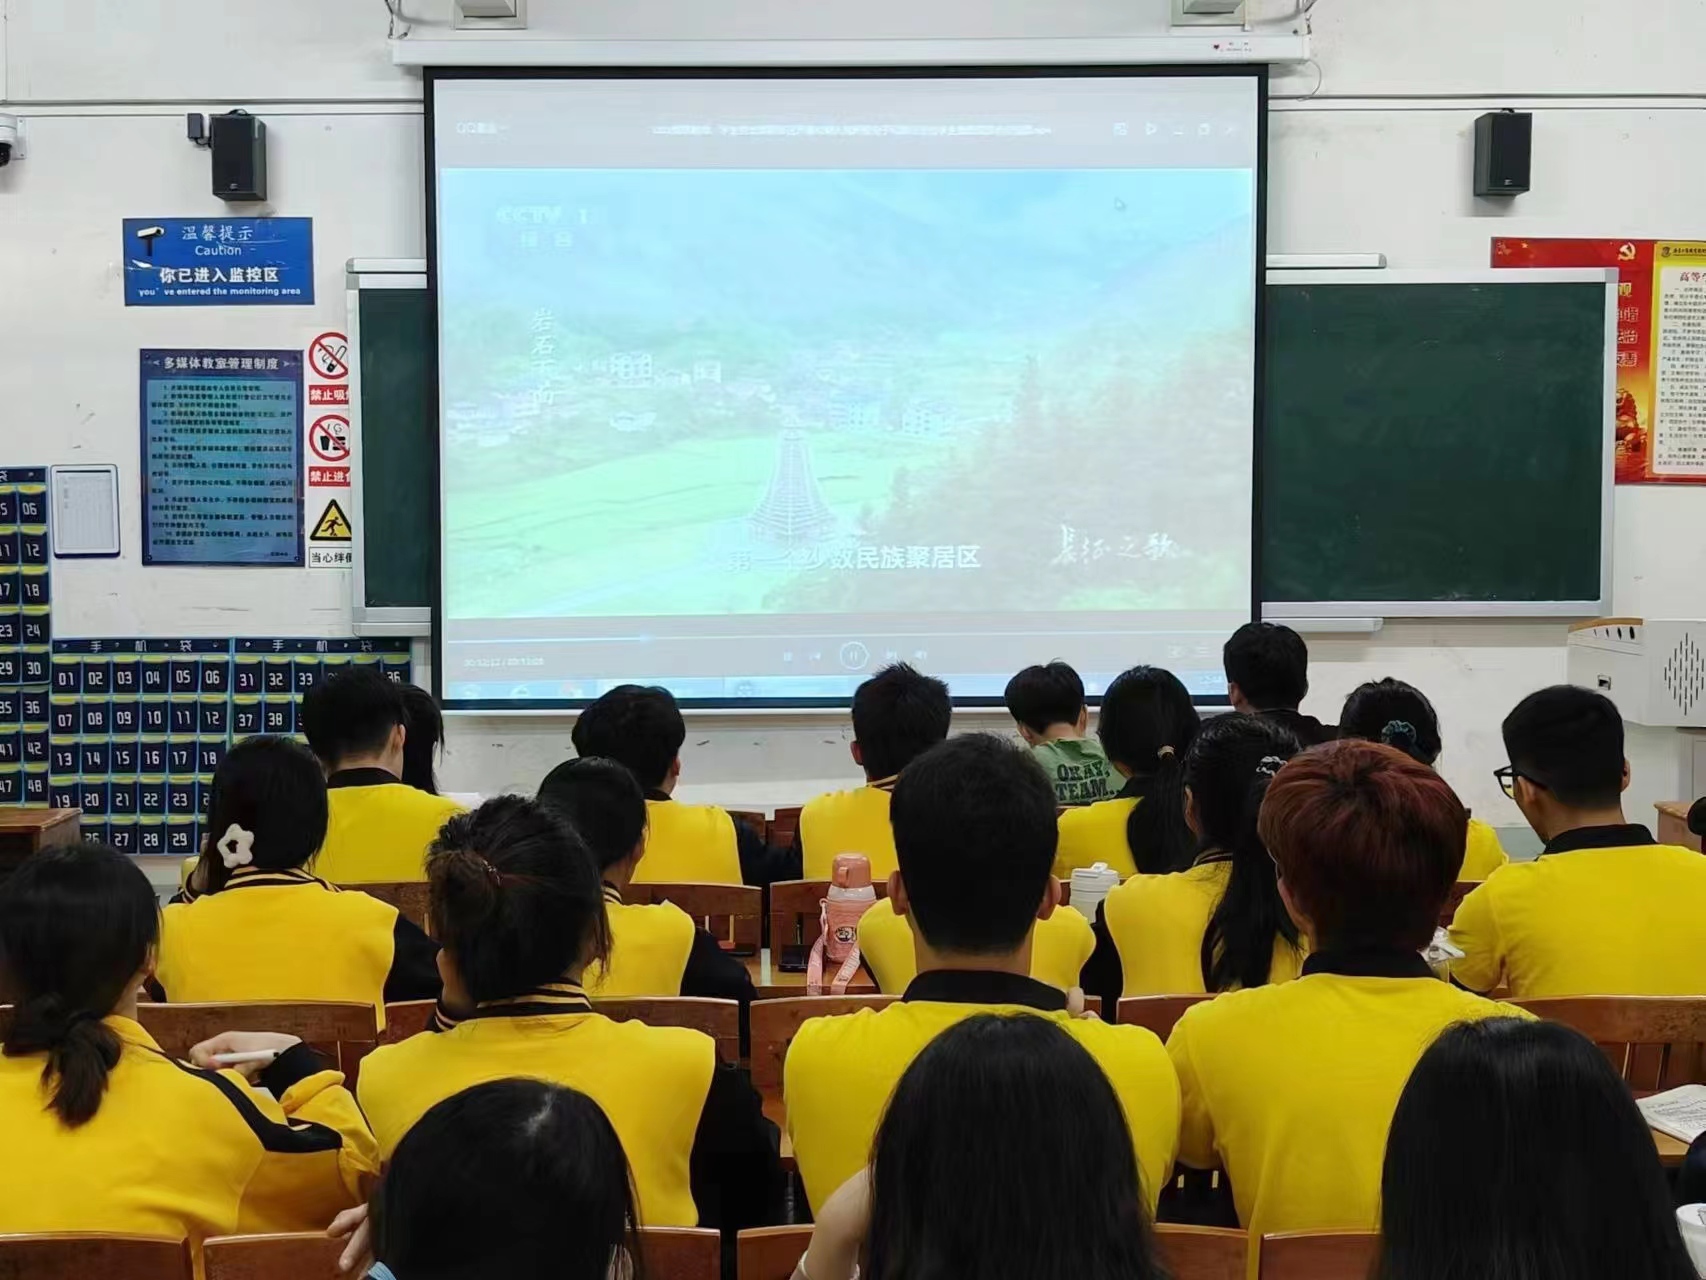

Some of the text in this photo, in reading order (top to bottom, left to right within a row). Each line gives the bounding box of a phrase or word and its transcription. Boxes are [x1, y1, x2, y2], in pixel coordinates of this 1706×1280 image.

[182, 224, 253, 241] 温馨提示
[195, 245, 242, 256] Caution
[159, 267, 280, 284] 你已进入监控区
[176, 287, 211, 296] entered
[212, 287, 227, 296] the
[230, 287, 279, 297] monitoring
[164, 356, 279, 370] 多媒体教室管理制度
[0, 502, 38, 516] 5 06
[26, 543, 40, 557] 12
[25, 583, 40, 597] 18
[26, 624, 41, 637] 24
[27, 661, 41, 675] 30
[58, 670, 220, 686] 01 02 03 04 05 06
[239, 673, 254, 687] 31
[268, 672, 283, 686] 32
[299, 672, 313, 686] 33
[25, 700, 40, 714] 36
[58, 710, 219, 727] 07 08 09 10 11 12
[238, 713, 253, 727] 37
[268, 712, 283, 726] 38
[27, 741, 42, 755] 42
[57, 750, 217, 767] 13 14 15 16 17 18
[28, 779, 42, 793] 48
[56, 794, 70, 808] 19
[84, 793, 99, 807] 20
[115, 793, 130, 806] 21
[143, 793, 159, 806] 22
[173, 793, 188, 807] 23
[114, 833, 129, 847] 27
[143, 833, 159, 847] 28
[172, 833, 188, 847] 29
